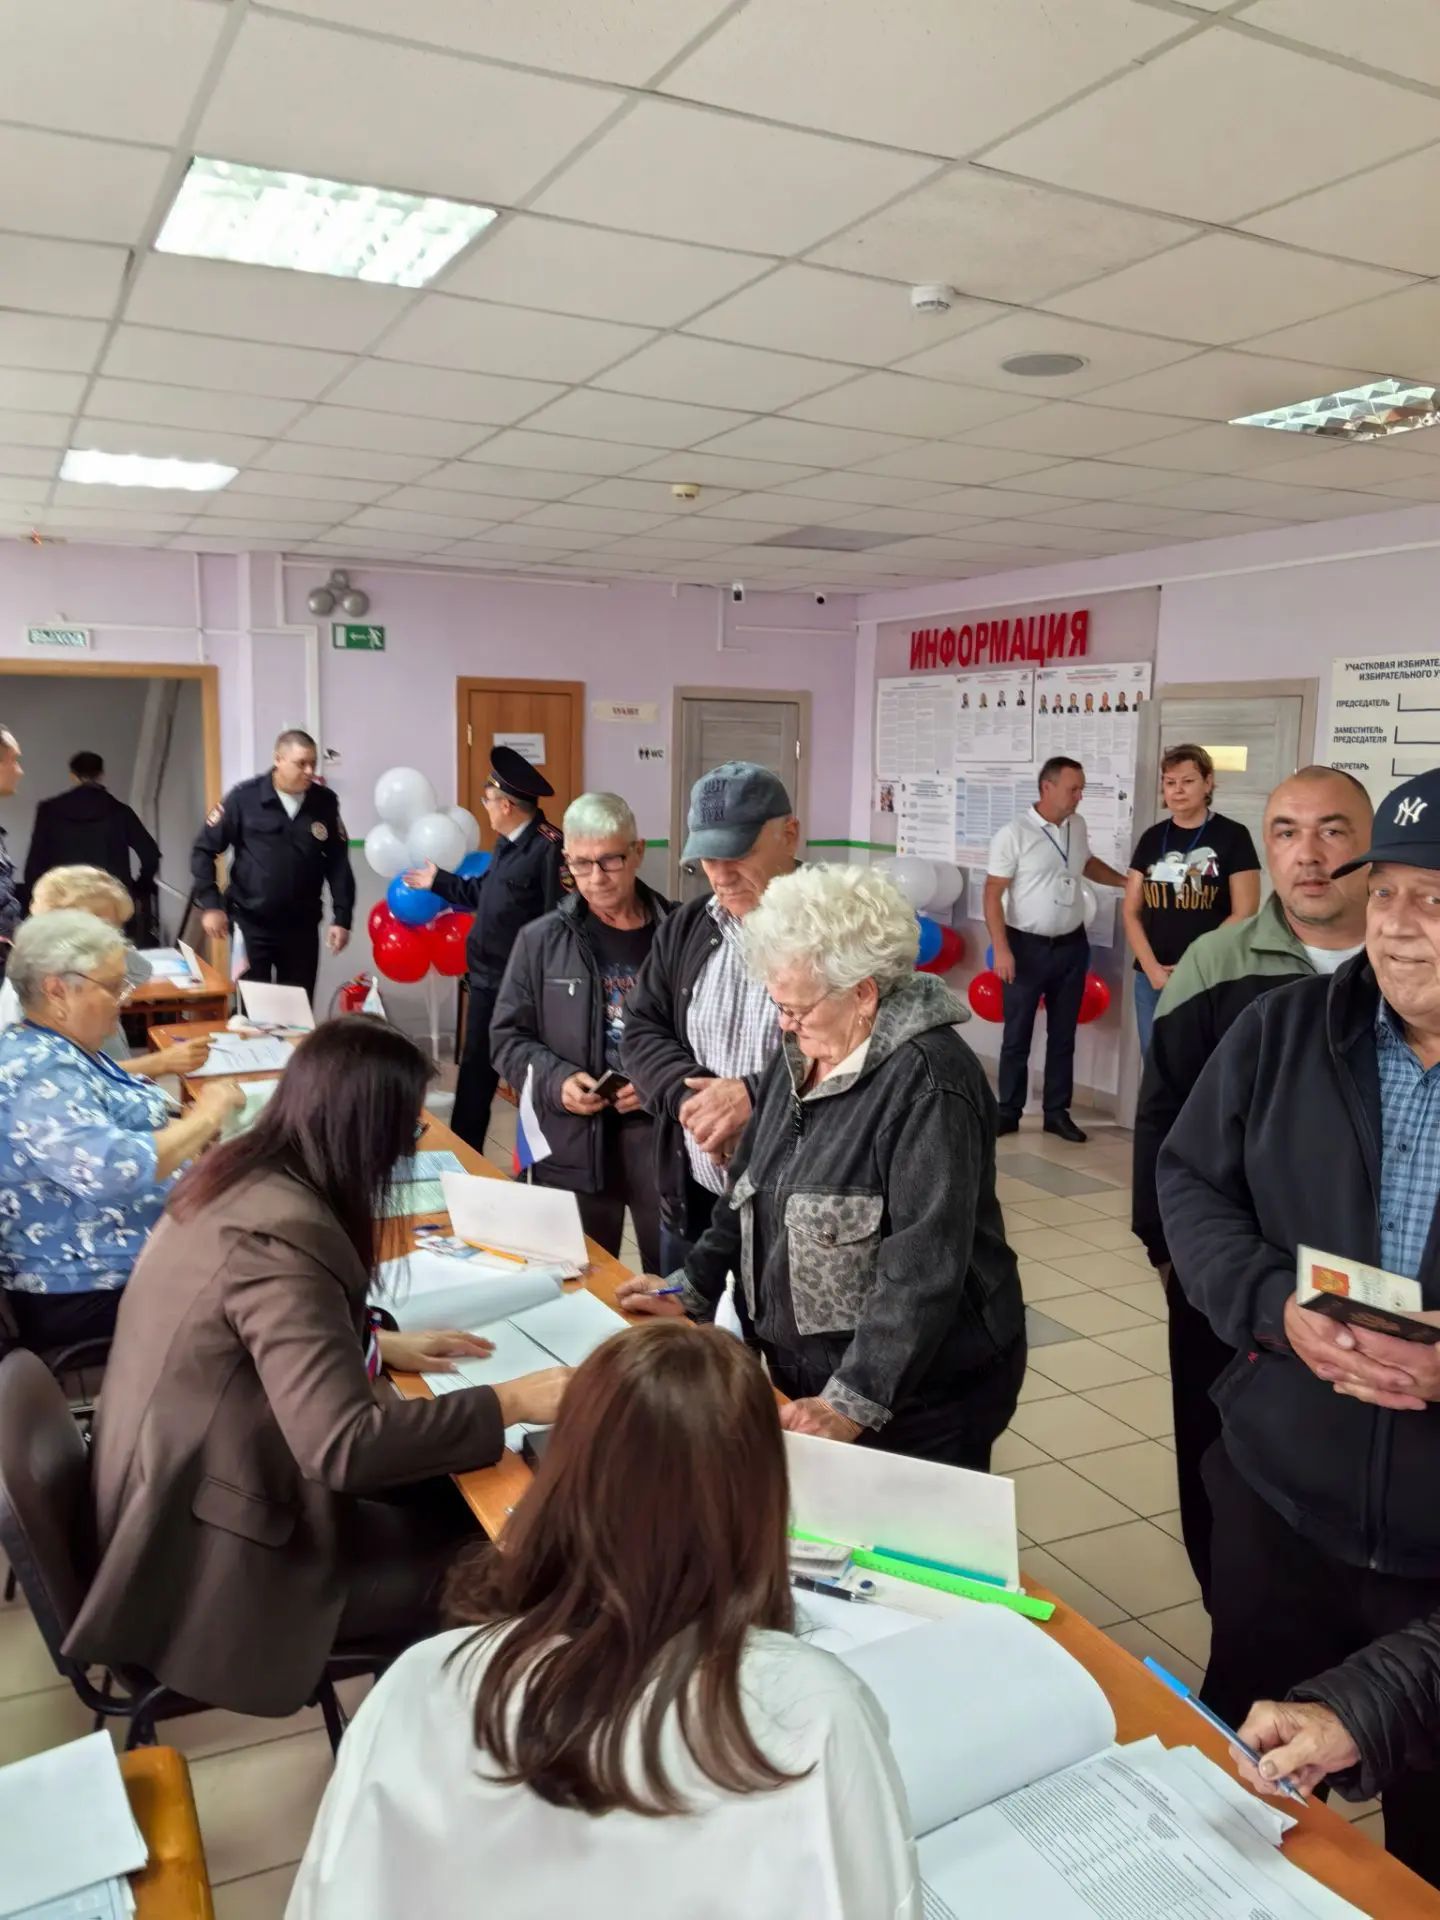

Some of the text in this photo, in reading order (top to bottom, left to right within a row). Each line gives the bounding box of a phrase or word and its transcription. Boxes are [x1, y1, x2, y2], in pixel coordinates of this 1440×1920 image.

[910, 610, 1089, 667] ИНФОРМАЦИЯ
[1345, 660, 1395, 671] УЧАСТКОВАЯ
[1359, 669, 1432, 681] ИЗБИРАТЕЛЬНОГО
[1336, 699, 1390, 708] ПРЕДСЕДАТЕЛЬ
[1334, 726, 1384, 734] ЗАМЕСТИТЕЛЬ
[1333, 736, 1387, 744] ПРЕДСЕДАТЕЛЯ
[1331, 762, 1370, 770] СЕКРЕТАРЬ
[1393, 796, 1428, 826] NY
[1142, 881, 1168, 909] NOT
